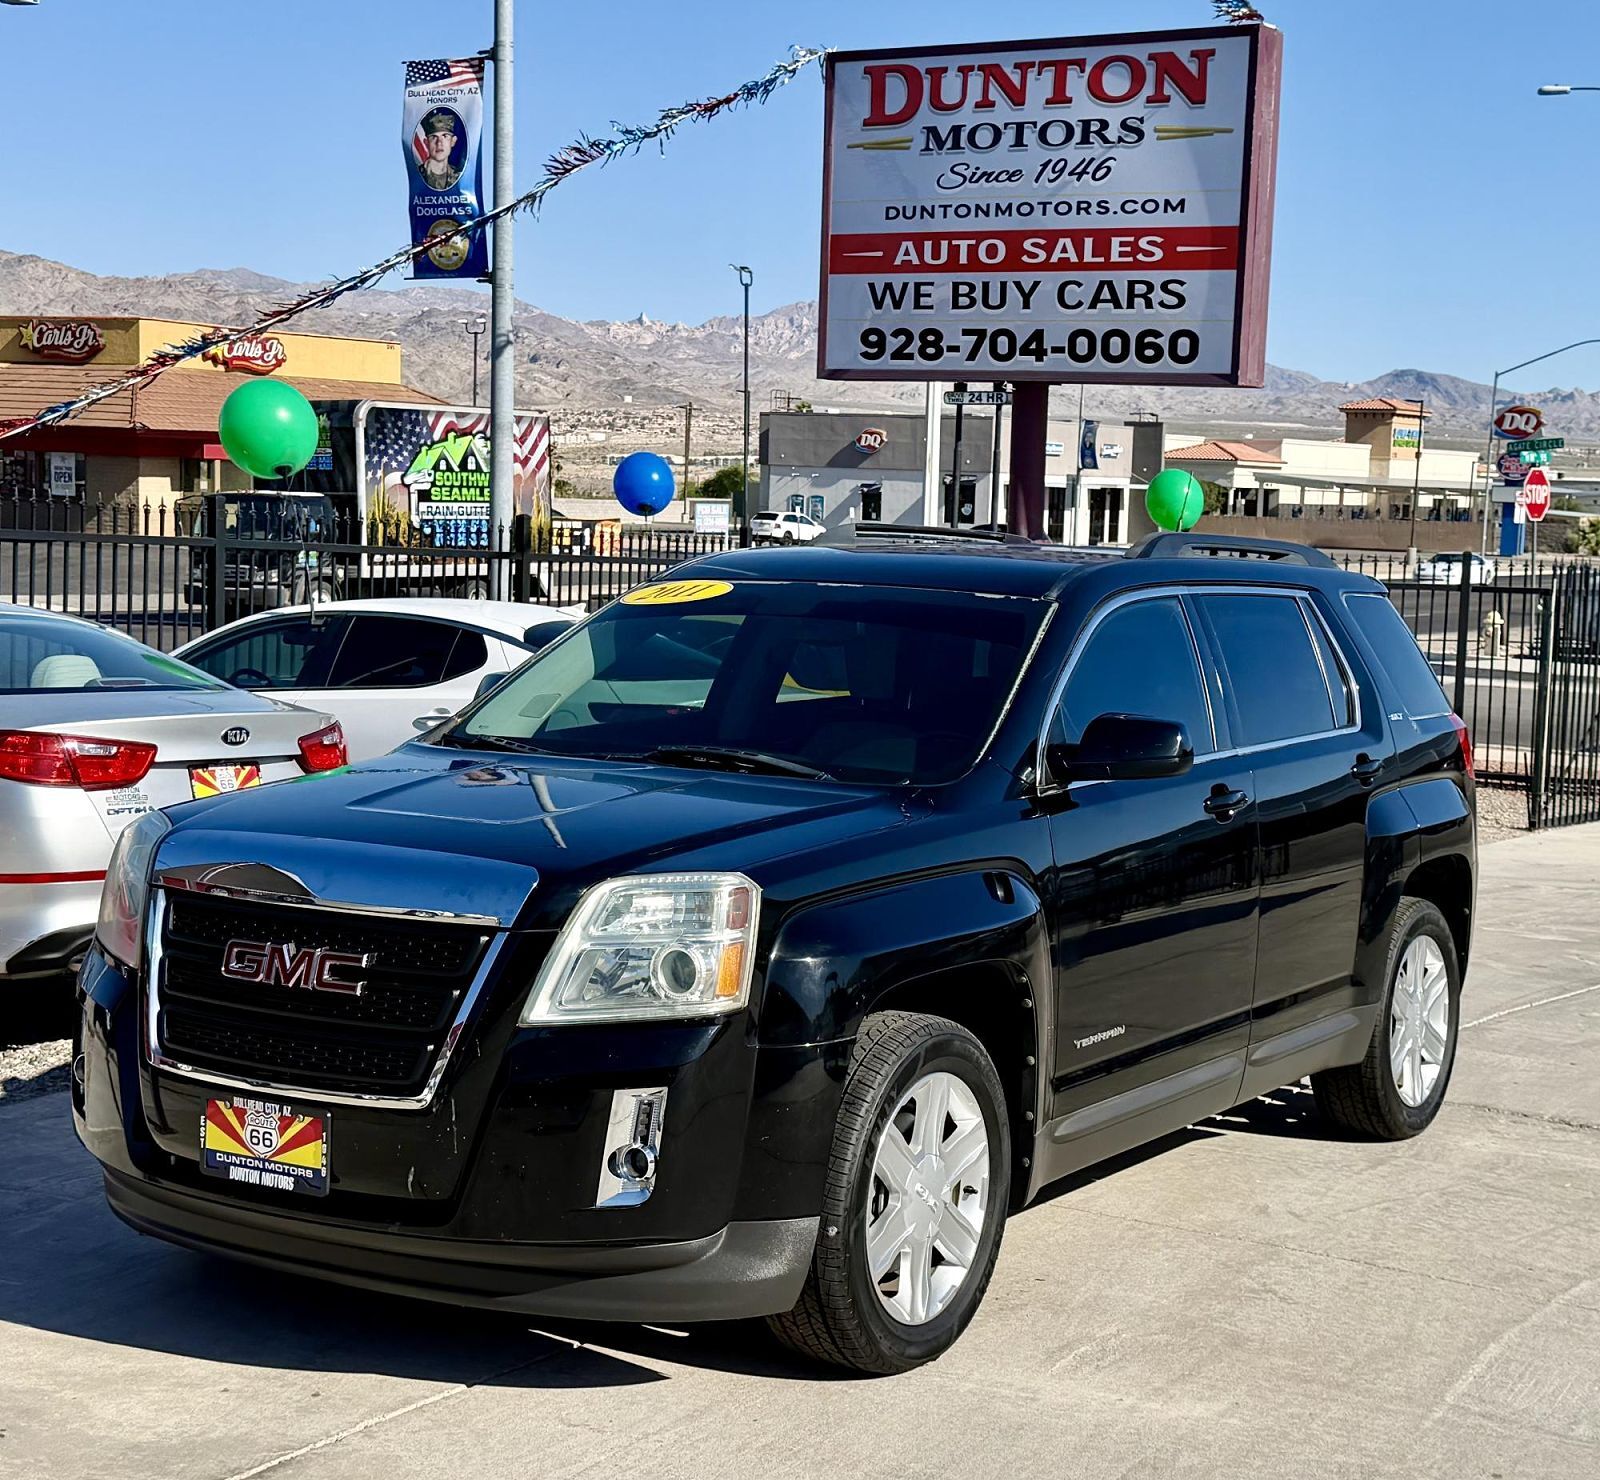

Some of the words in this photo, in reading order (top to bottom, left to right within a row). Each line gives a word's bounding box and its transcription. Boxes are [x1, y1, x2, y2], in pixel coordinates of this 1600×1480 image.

[407, 89, 447, 98] BULLHEAD
[448, 88, 466, 97] CITY,
[467, 87, 479, 95] AZ
[861, 48, 1216, 128] DUNTON
[426, 96, 458, 104] HONORS
[920, 115, 1146, 153] MOTORS
[936, 161, 1024, 190] Since
[1033, 155, 1118, 185] 1946
[416, 206, 473, 216] DOUGLASS
[884, 198, 1187, 221] DUNTONMOTORS.COM
[893, 239, 1007, 266] AUTO
[1020, 235, 1165, 264] SALES
[867, 281, 936, 310] WE
[951, 279, 1042, 310] BUY
[1056, 278, 1188, 310] CARS
[32, 324, 74, 348] Carl's
[73, 325, 99, 349] Jr.
[859, 327, 1200, 364] 928-704-0060
[263, 340, 286, 362] Jr.
[968, 393, 982, 403] 24
[986, 393, 1004, 404] HR
[1501, 412, 1538, 433] DQ
[860, 433, 882, 448] DQ
[1508, 441, 1531, 451] AGATE
[1534, 439, 1563, 449] CIRCLE
[54, 471, 73, 483] OPEN
[1525, 484, 1549, 505] STOP
[426, 505, 453, 516] RAIN
[634, 583, 716, 601] 2011
[227, 730, 247, 742] KIA
[219, 779, 235, 790] 66
[222, 939, 368, 996] GMC
[1074, 1024, 1126, 1049] TERRAIN
[233, 1096, 264, 1111] BULLHEAD
[282, 1105, 292, 1117] AZ
[250, 1116, 274, 1128] ROUTE
[250, 1129, 273, 1148] 66
[216, 1152, 263, 1169] DUNTON
[264, 1162, 314, 1178] MOTORS
[229, 1165, 260, 1185] DUNTON
[260, 1171, 294, 1191] MOTORS
